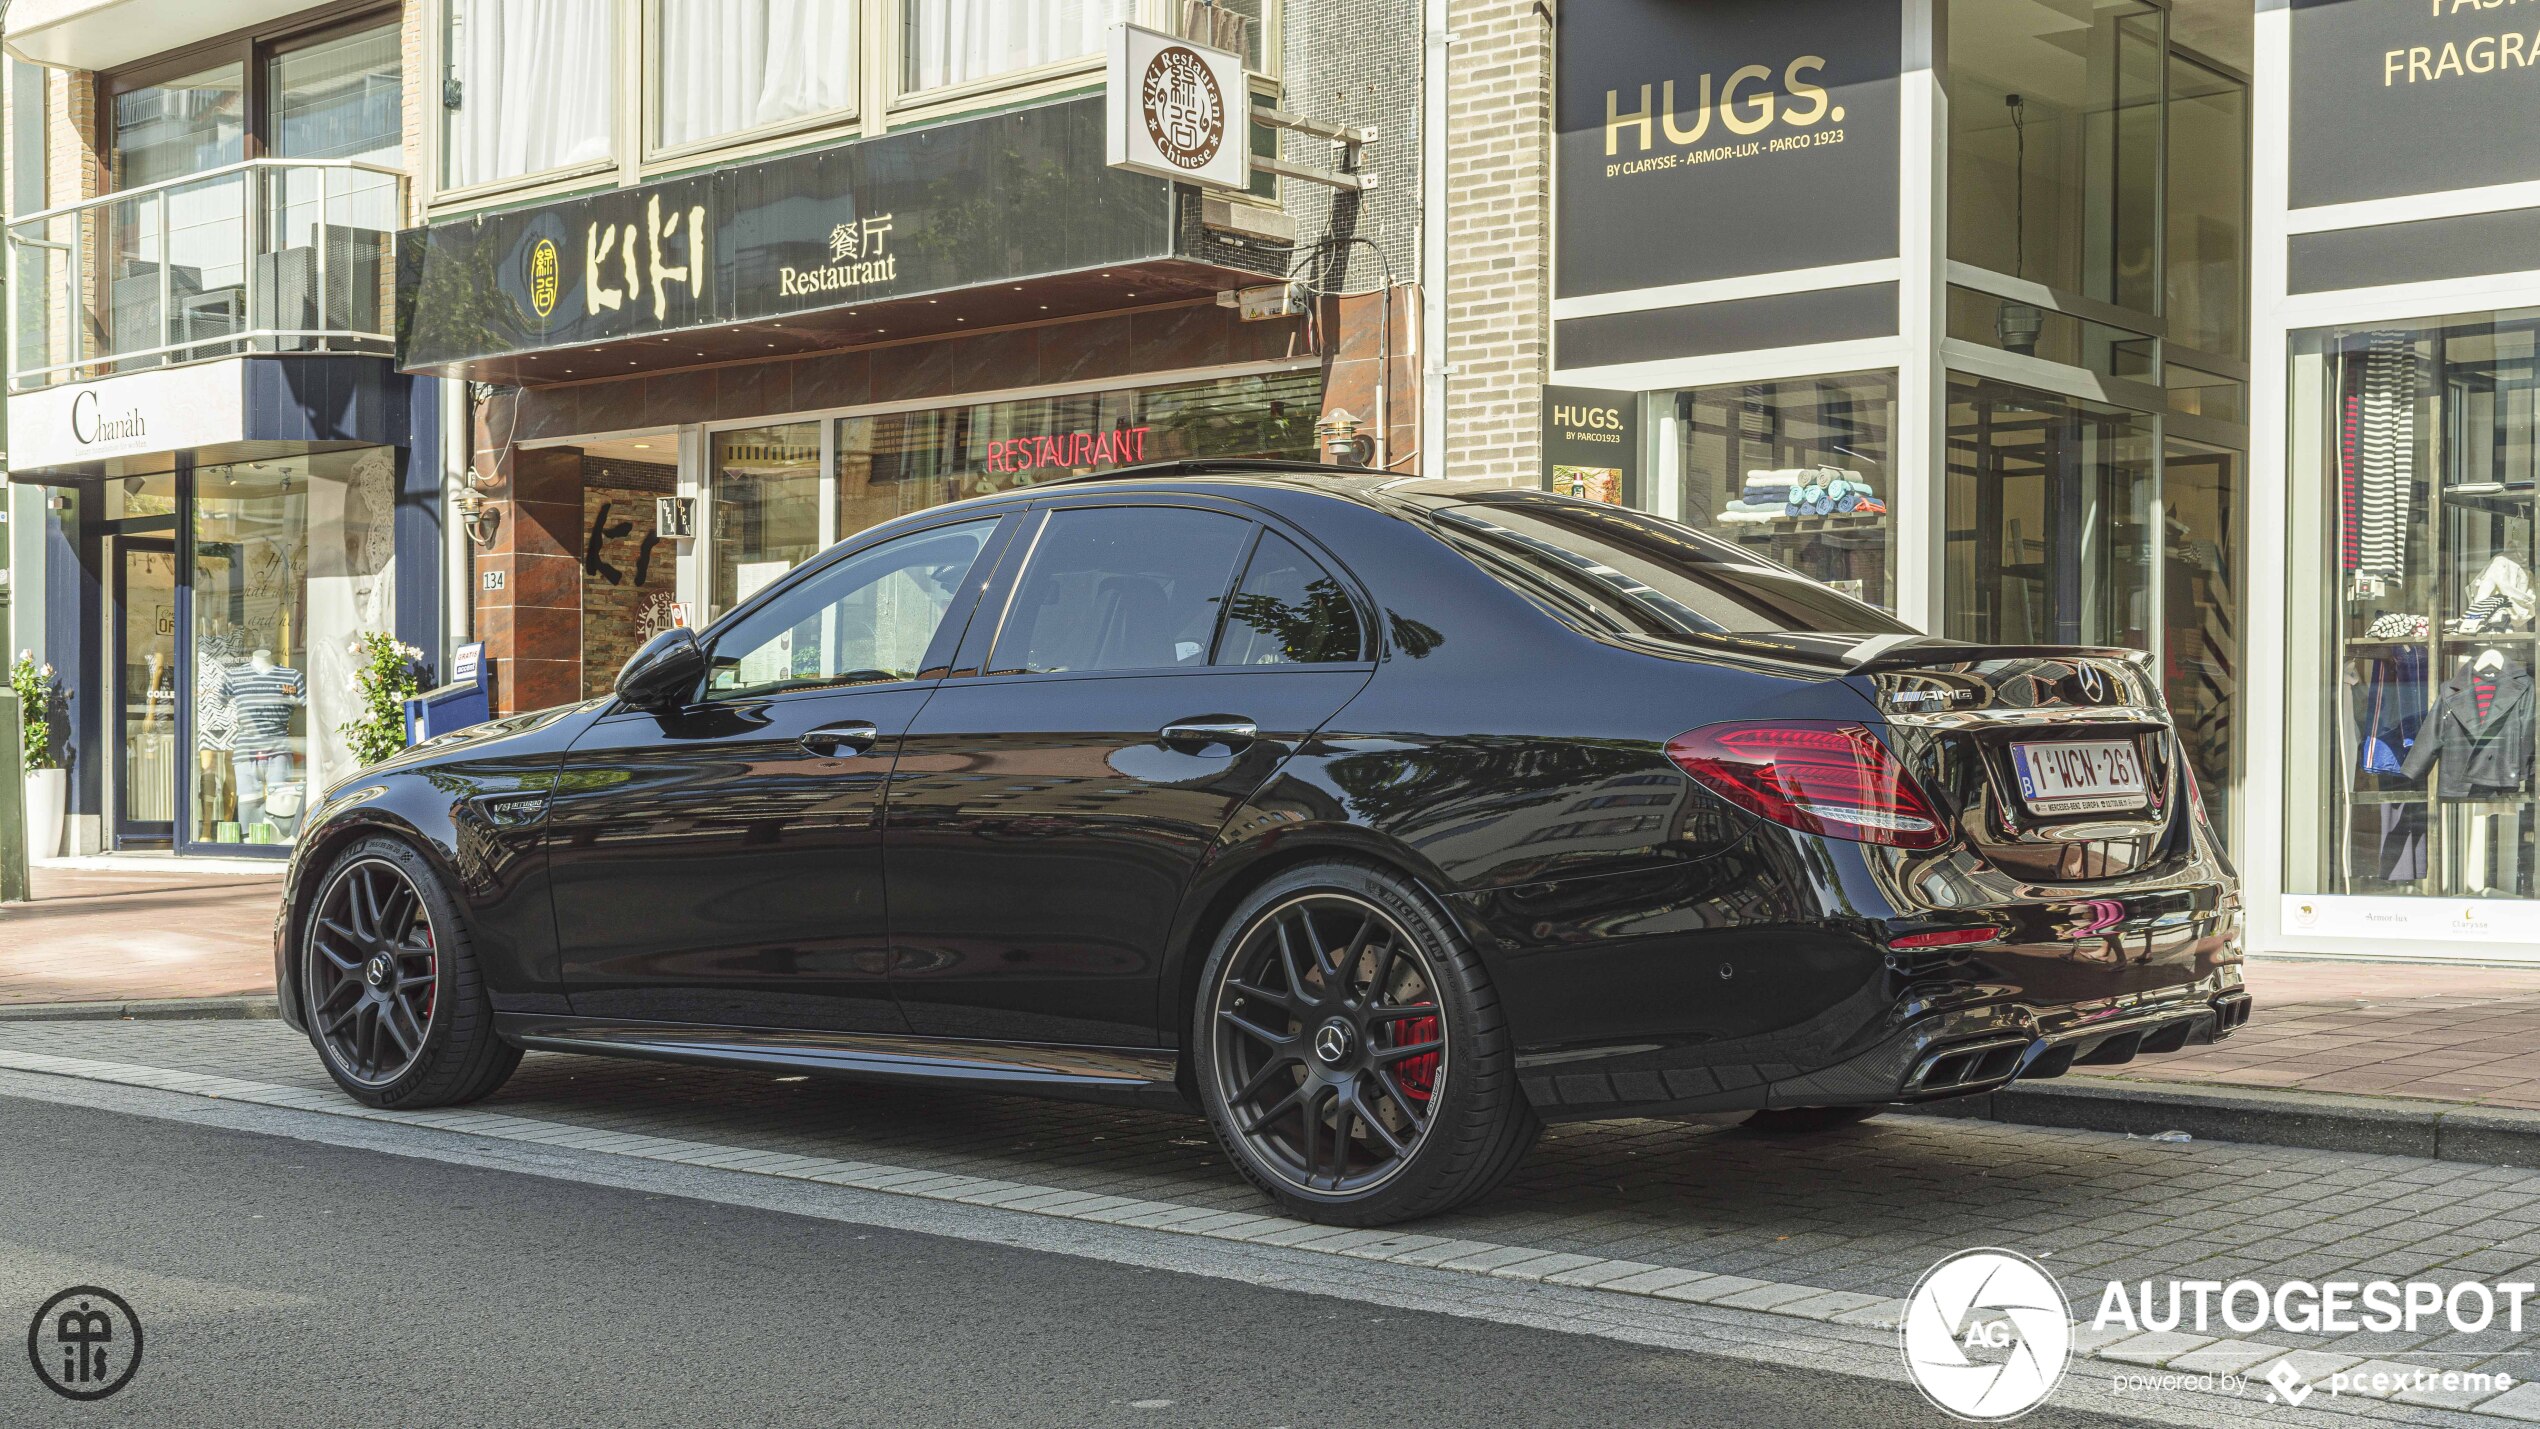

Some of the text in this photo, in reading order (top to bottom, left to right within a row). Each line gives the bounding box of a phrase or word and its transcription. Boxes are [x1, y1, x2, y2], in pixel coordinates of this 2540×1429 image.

[1161, 52, 1222, 128] Restaurant
[1606, 55, 1846, 156] HUGS.
[1157, 137, 1212, 168] Chinese
[1606, 163, 1621, 177] BY
[1622, 155, 1677, 175] CLARYSSE
[1686, 142, 1759, 166] ARMOR-LUX
[1769, 134, 1810, 152] PARCO
[1813, 129, 1844, 146] 1923
[829, 212, 893, 264] 餐厅
[779, 253, 897, 297] Restaurant
[72, 390, 145, 444] Chanàh
[1554, 405, 1624, 431] HUGS.
[987, 427, 1152, 474] RESTAURANT
[1566, 431, 1620, 442] BY PARCO1923
[662, 500, 675, 533] OPEN
[676, 498, 690, 535] OPEN
[484, 572, 503, 590] 134
[457, 651, 478, 661] GRATIS
[1921, 688, 1973, 701] AMG
[2022, 777, 2033, 796] B
[2047, 801, 2080, 812] MERCEDES-BENZ
[2082, 801, 2100, 809] EUROPA
[1383, 891, 1444, 959] MICHELIN
[2365, 912, 2392, 921] Armor
